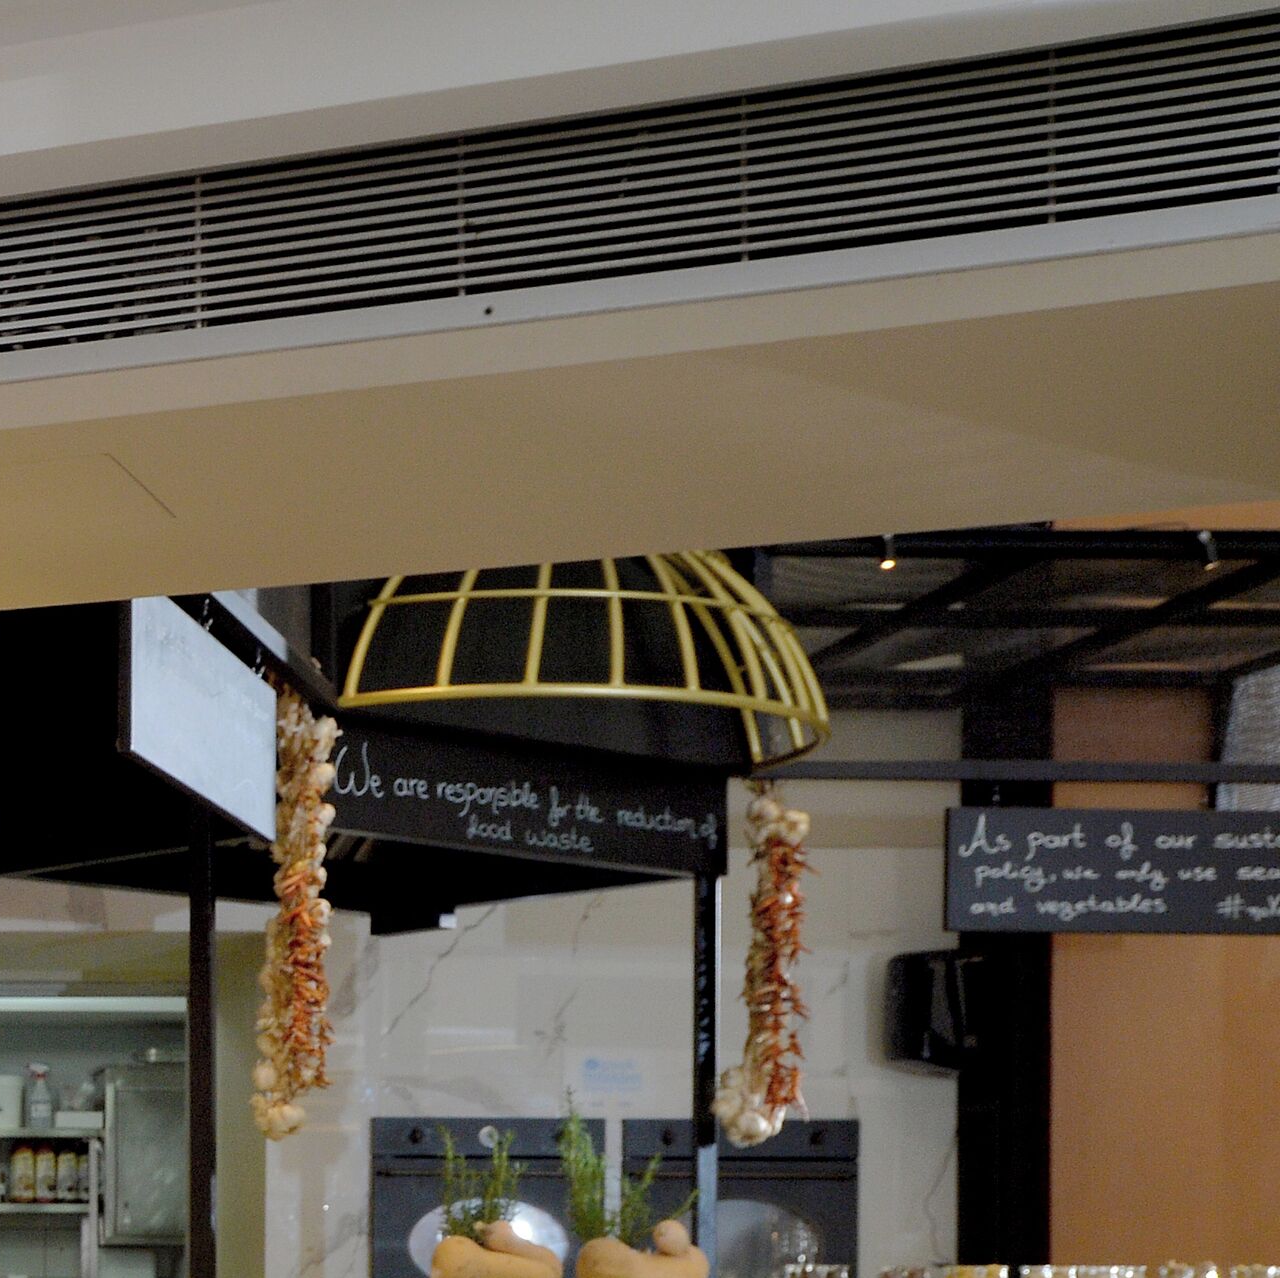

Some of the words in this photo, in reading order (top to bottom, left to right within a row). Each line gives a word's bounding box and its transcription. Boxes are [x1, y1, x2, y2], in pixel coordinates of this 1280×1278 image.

[333, 741, 385, 799] We
[393, 776, 430, 800] are
[436, 780, 540, 818] responsible
[548, 785, 572, 827] for
[575, 794, 605, 824] the
[616, 805, 699, 840] reduction
[699, 812, 718, 850] of
[466, 813, 513, 842] food
[524, 827, 594, 853] waste
[958, 812, 1013, 858] As
[1025, 822, 1088, 862] part
[1104, 821, 1139, 861] of
[1154, 833, 1198, 850] our
[1062, 865, 1101, 881] we
[1114, 861, 1169, 892] only
[1176, 865, 1218, 882] use
[969, 895, 1018, 917] and
[1035, 892, 1169, 923] vegetables
